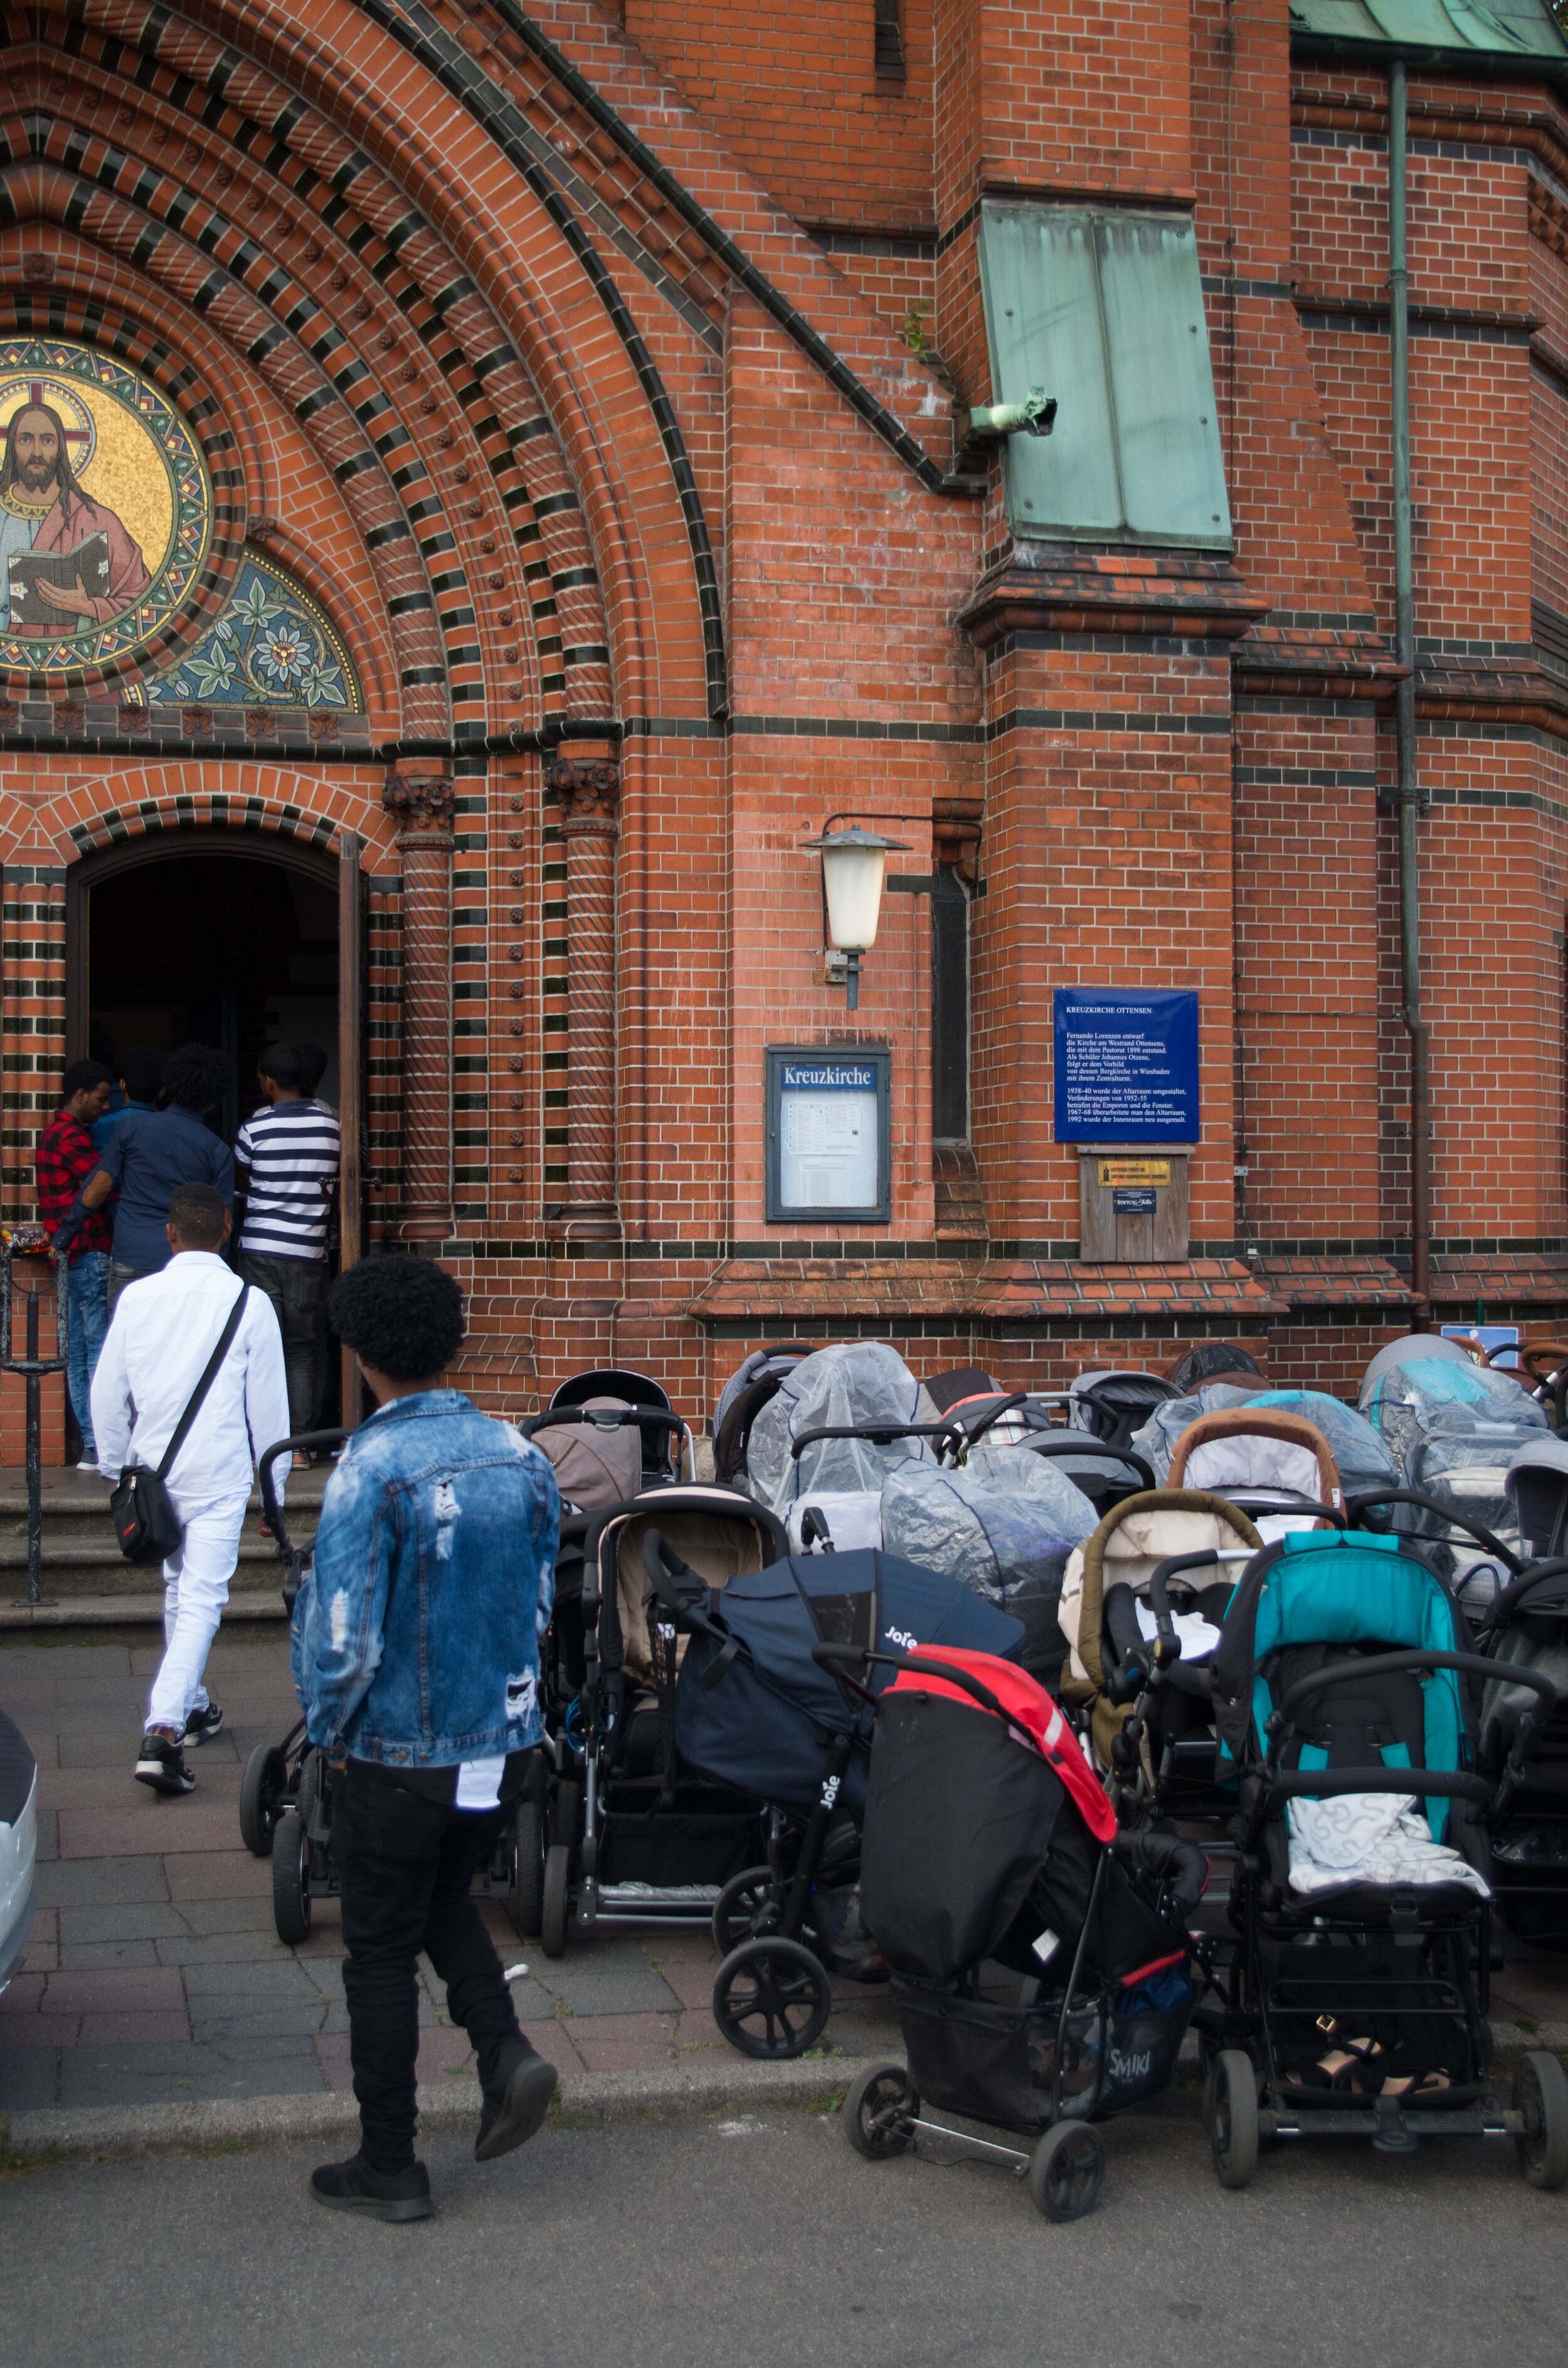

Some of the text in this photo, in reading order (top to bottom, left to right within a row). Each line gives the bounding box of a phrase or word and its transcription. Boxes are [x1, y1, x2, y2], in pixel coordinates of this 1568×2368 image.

[784, 1066, 871, 1085] Kreuzkirche
[885, 1626, 918, 1650] Joie
[820, 1775, 840, 1809] Joie
[1109, 2048, 1150, 2077] SMIKI
